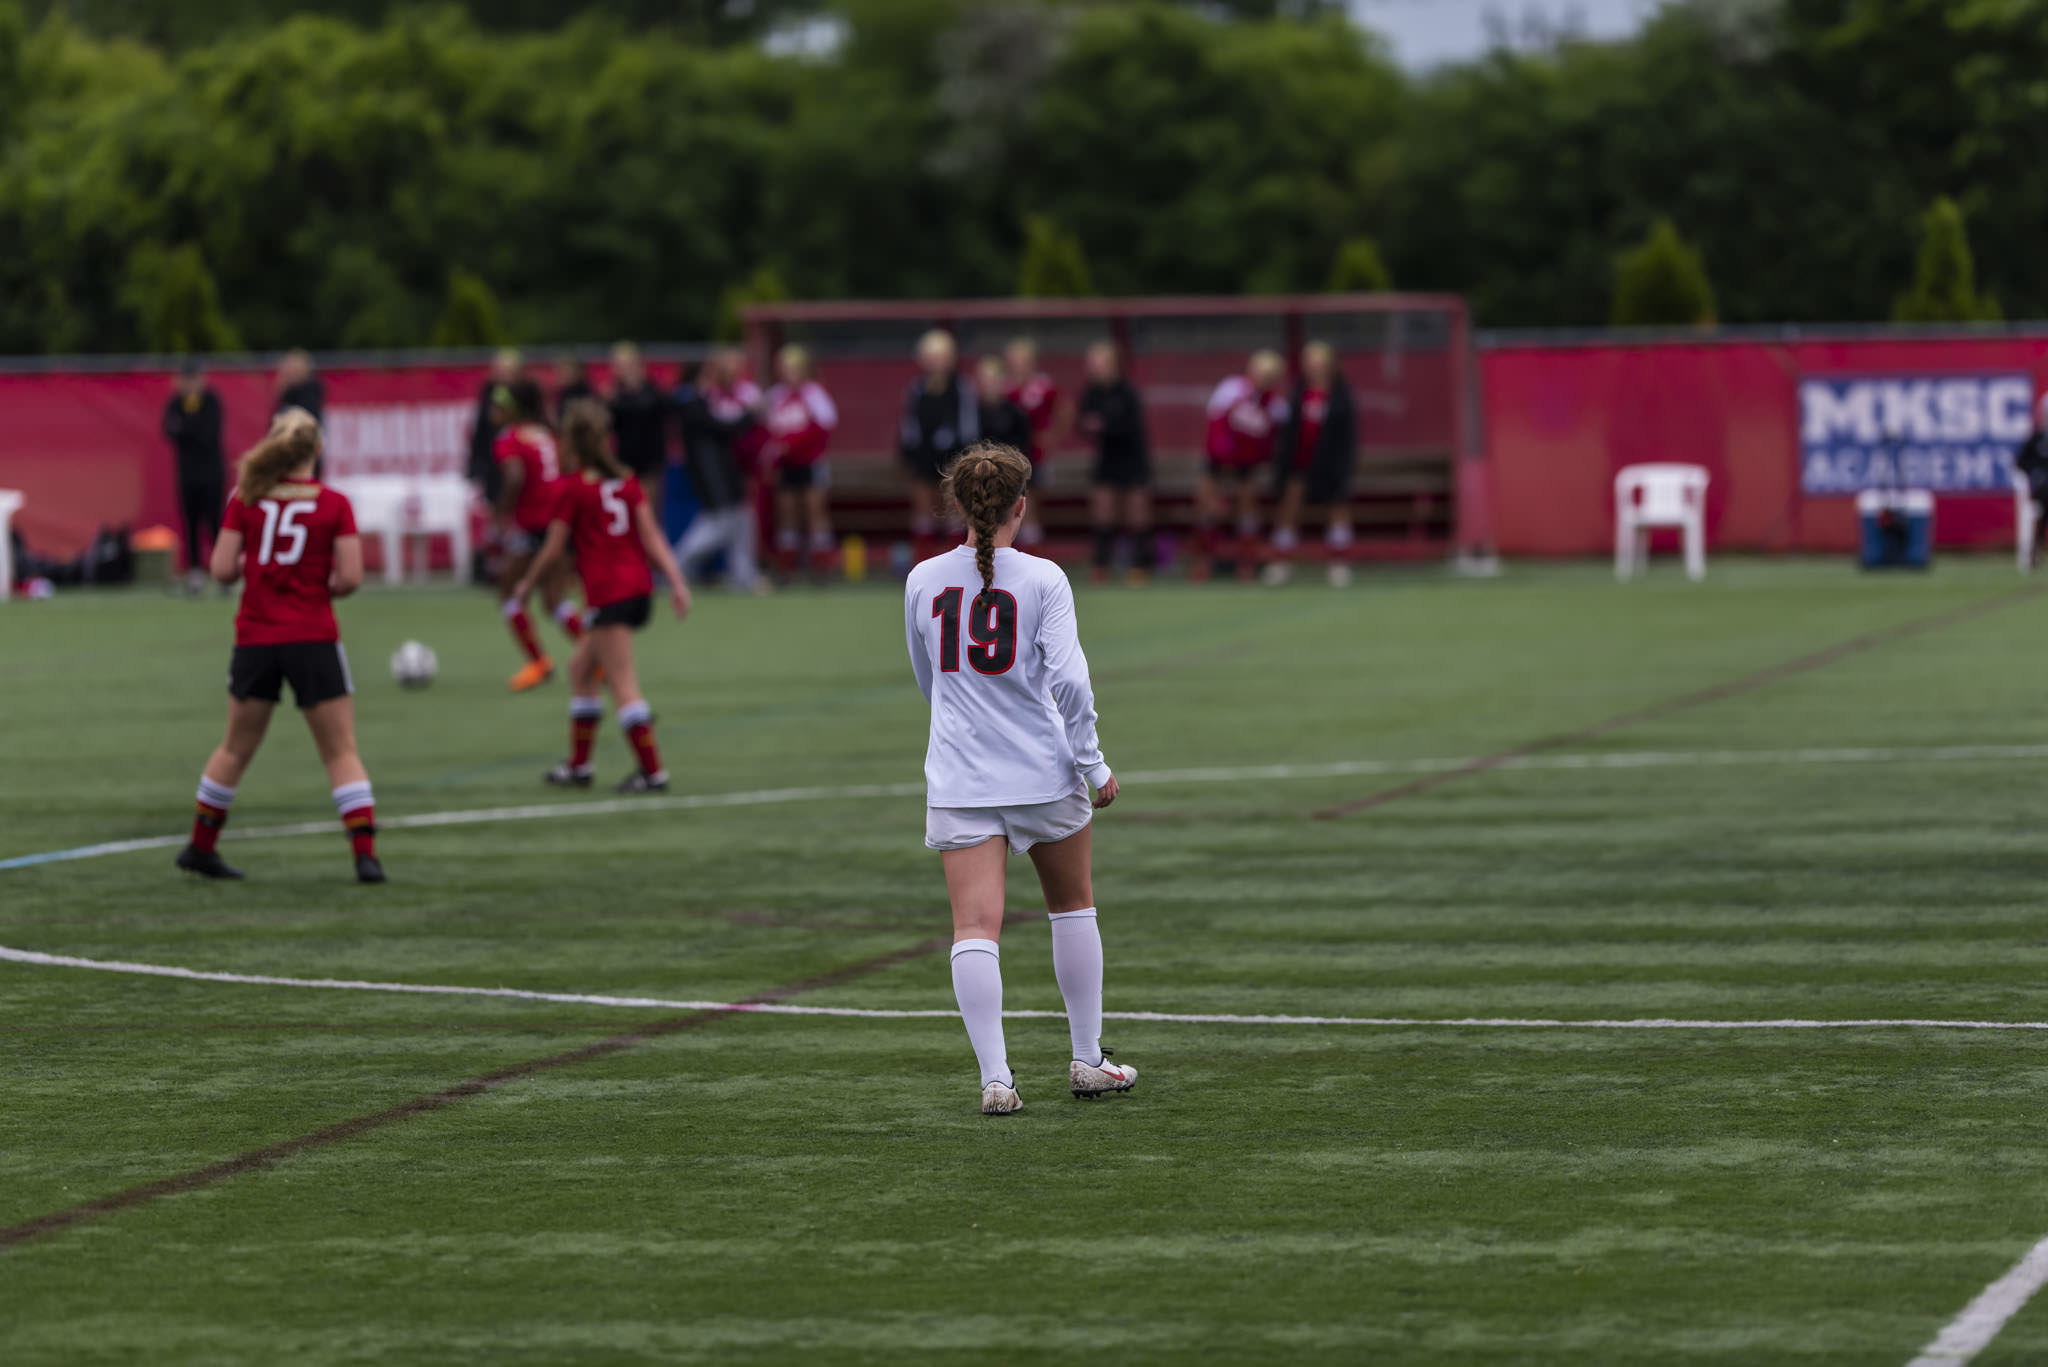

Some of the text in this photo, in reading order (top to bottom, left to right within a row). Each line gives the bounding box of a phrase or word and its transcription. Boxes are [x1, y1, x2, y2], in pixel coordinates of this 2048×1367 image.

[1803, 377, 2032, 441] MKSC
[257, 499, 318, 566] 15
[599, 480, 630, 536] 5
[931, 586, 1018, 675] 19
